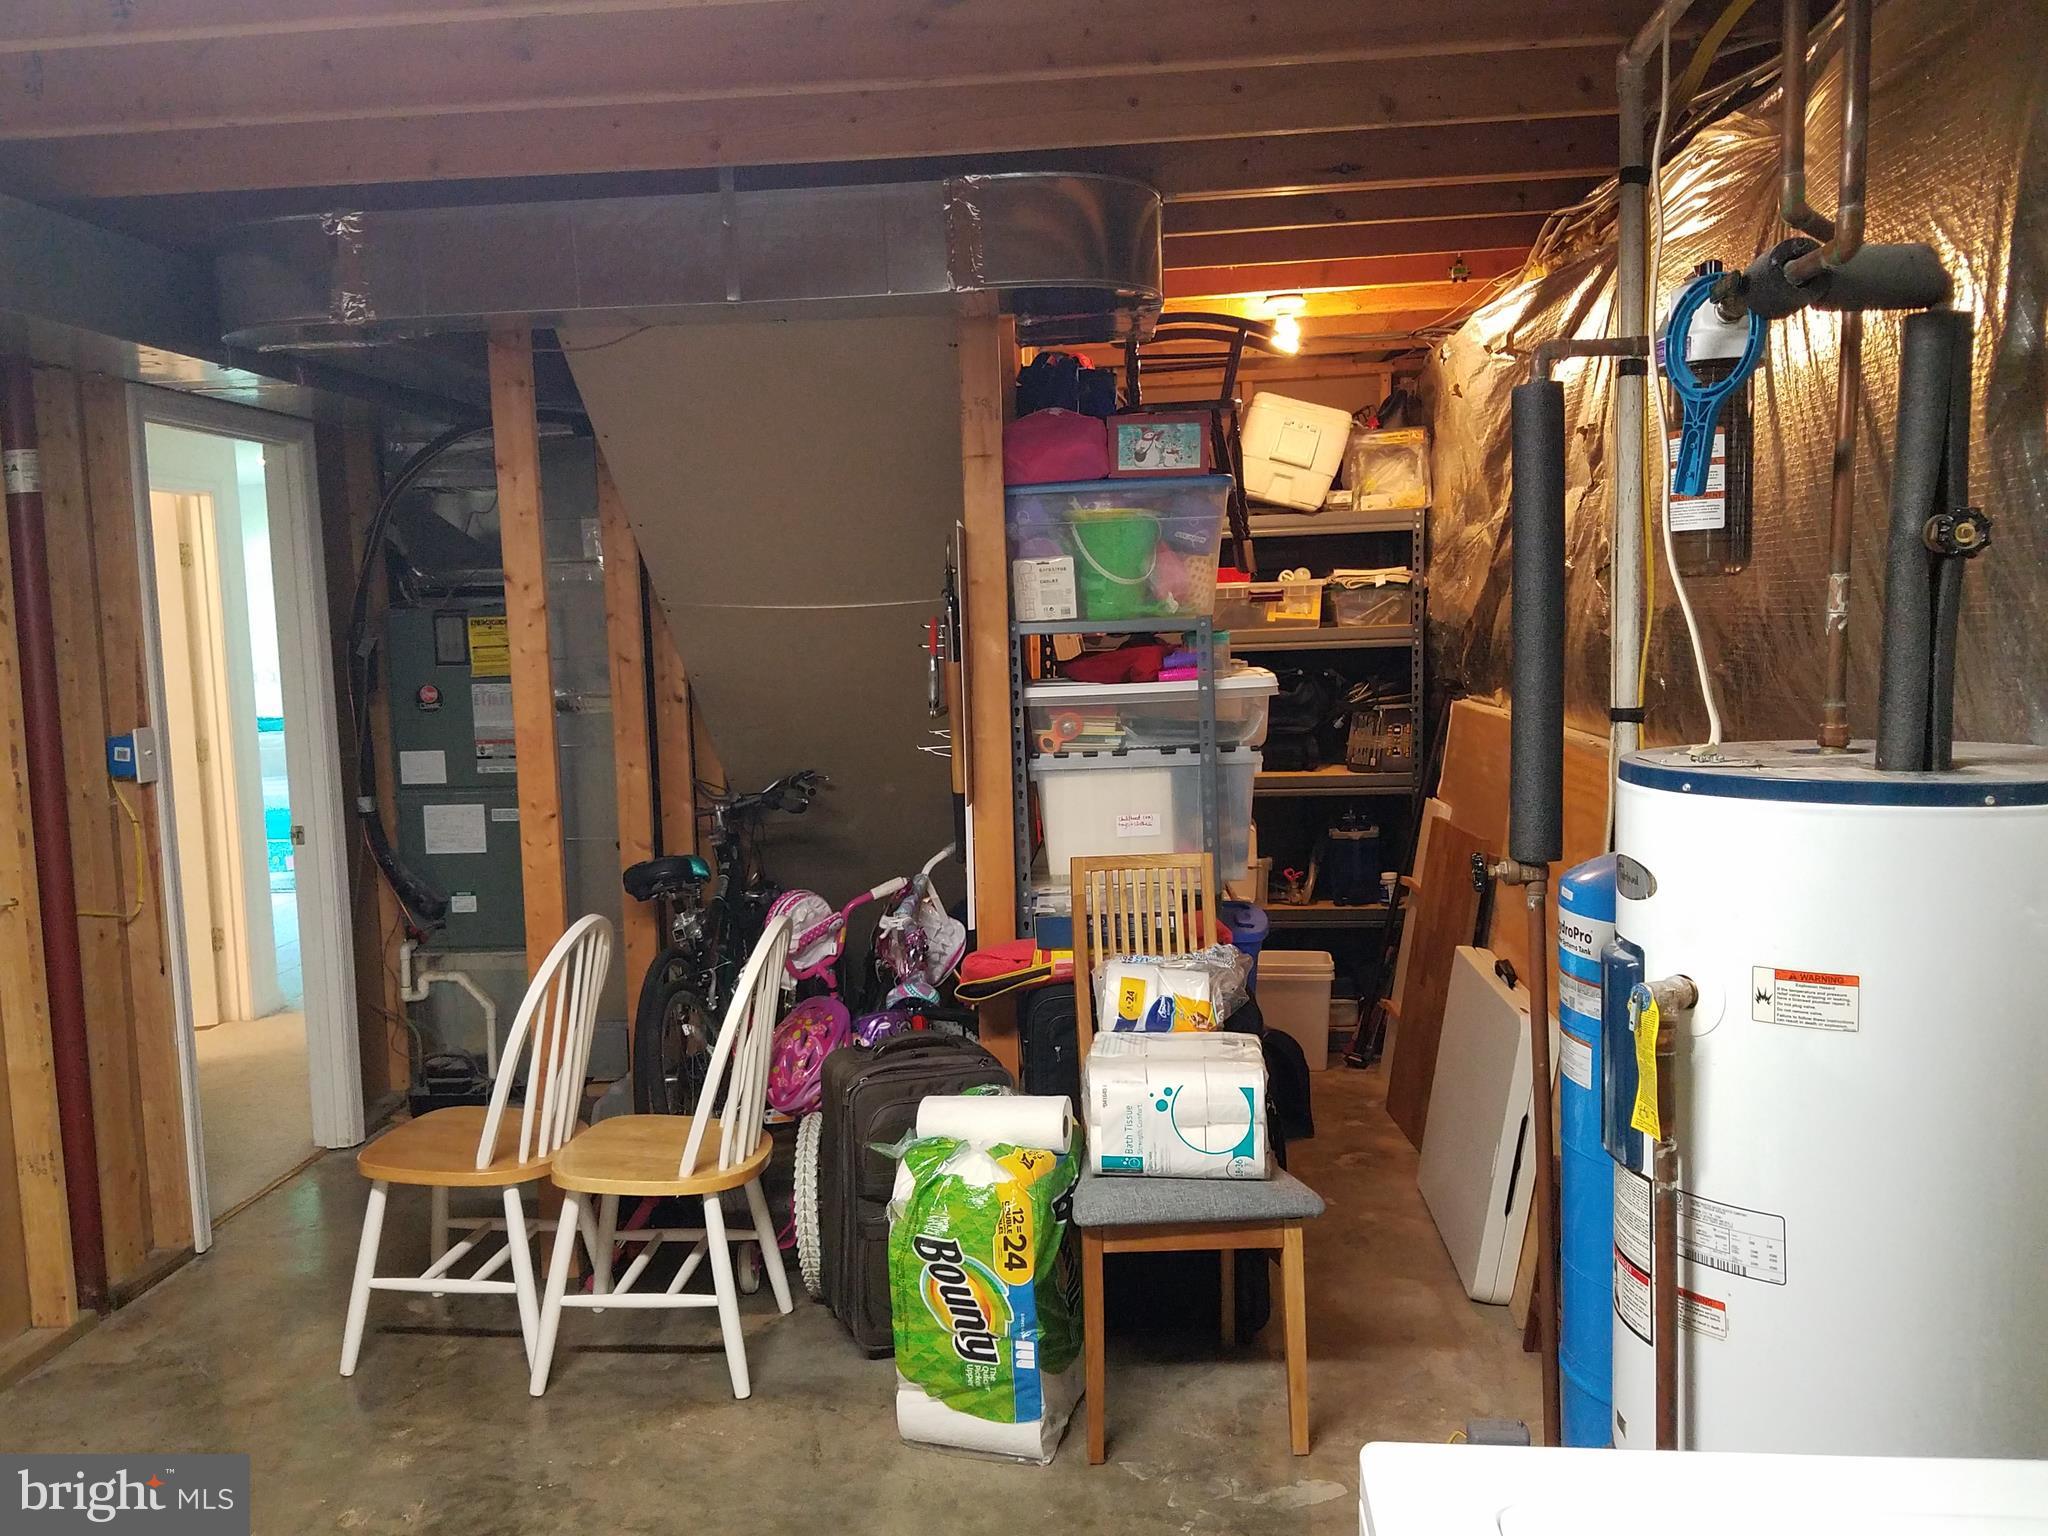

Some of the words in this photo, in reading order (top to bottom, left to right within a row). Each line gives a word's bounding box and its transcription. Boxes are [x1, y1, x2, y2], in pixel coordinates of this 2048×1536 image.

[1800, 974, 1844, 984] WARNING
[1124, 1105, 1133, 1132] Tissue
[1124, 1134, 1134, 1154] Bath
[914, 1236, 998, 1364] Bounty
[989, 1366, 997, 1382] The
